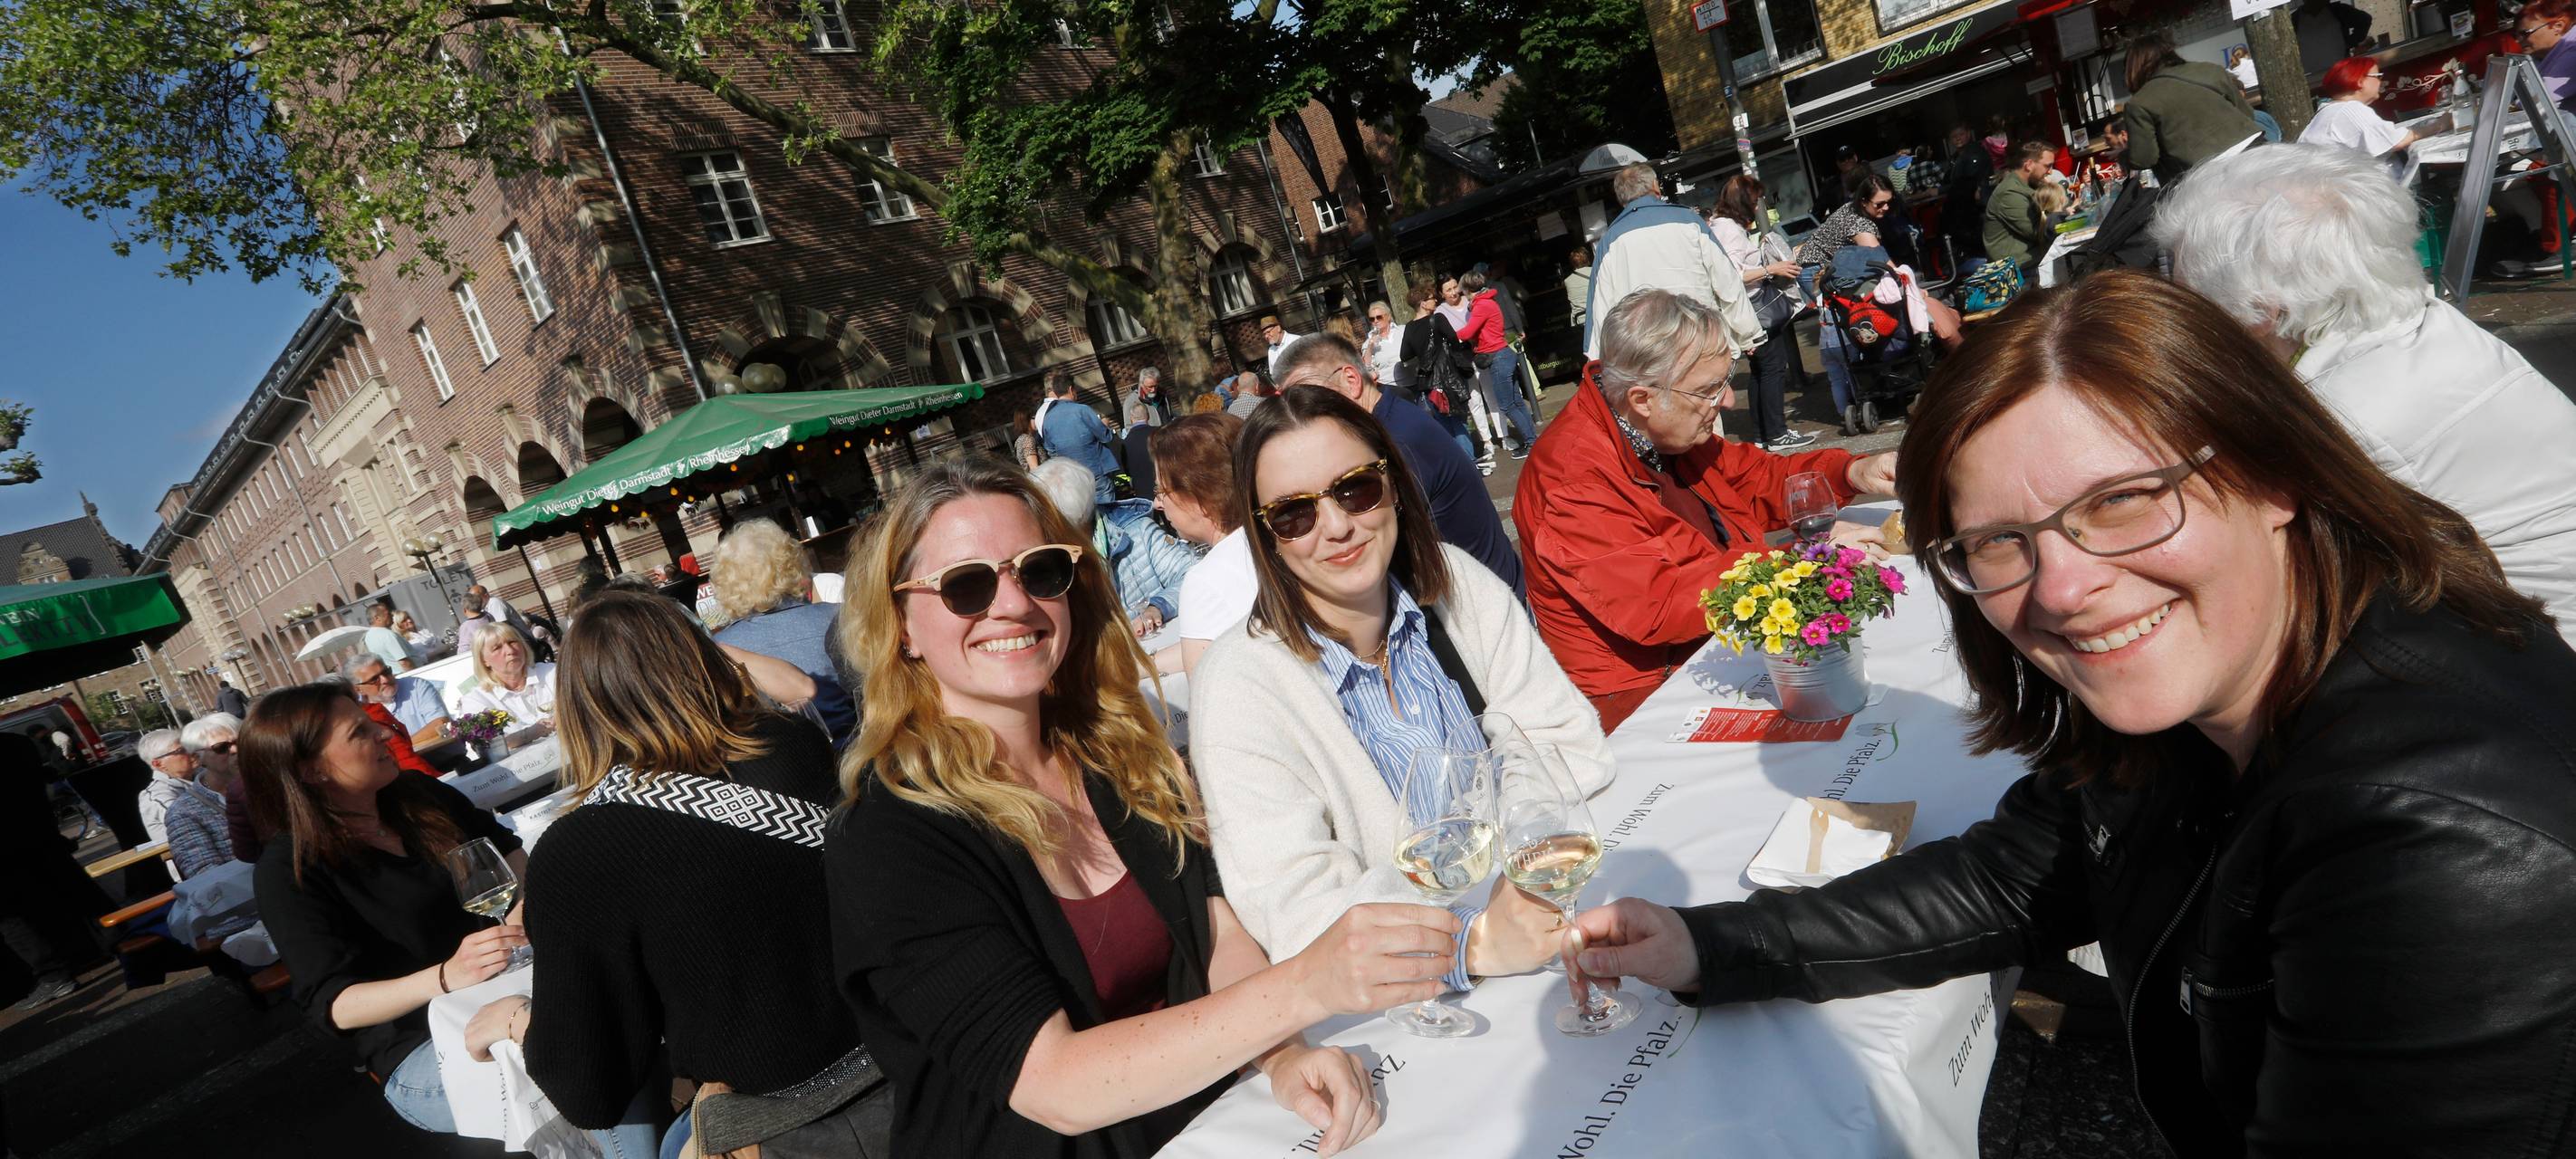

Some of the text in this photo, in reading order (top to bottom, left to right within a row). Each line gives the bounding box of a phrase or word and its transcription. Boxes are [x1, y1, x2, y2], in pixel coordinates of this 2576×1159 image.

[1872, 18, 1974, 74] Bischoff
[829, 391, 963, 426] Weingut Dieter Darmstadt Rheinhessen
[543, 445, 751, 514] Weingut Dieter Darmstadt Rheinhessen
[1831, 767, 1861, 785] Die
[1847, 738, 1882, 766] Pfalz.
[1602, 783, 1675, 851] Zum Wohl. Di
[1371, 1054, 1406, 1087] Zu
[1600, 1072, 1642, 1106] Die
[1627, 1015, 1682, 1068] Pfalz.
[1948, 1035, 1973, 1087] Zum
